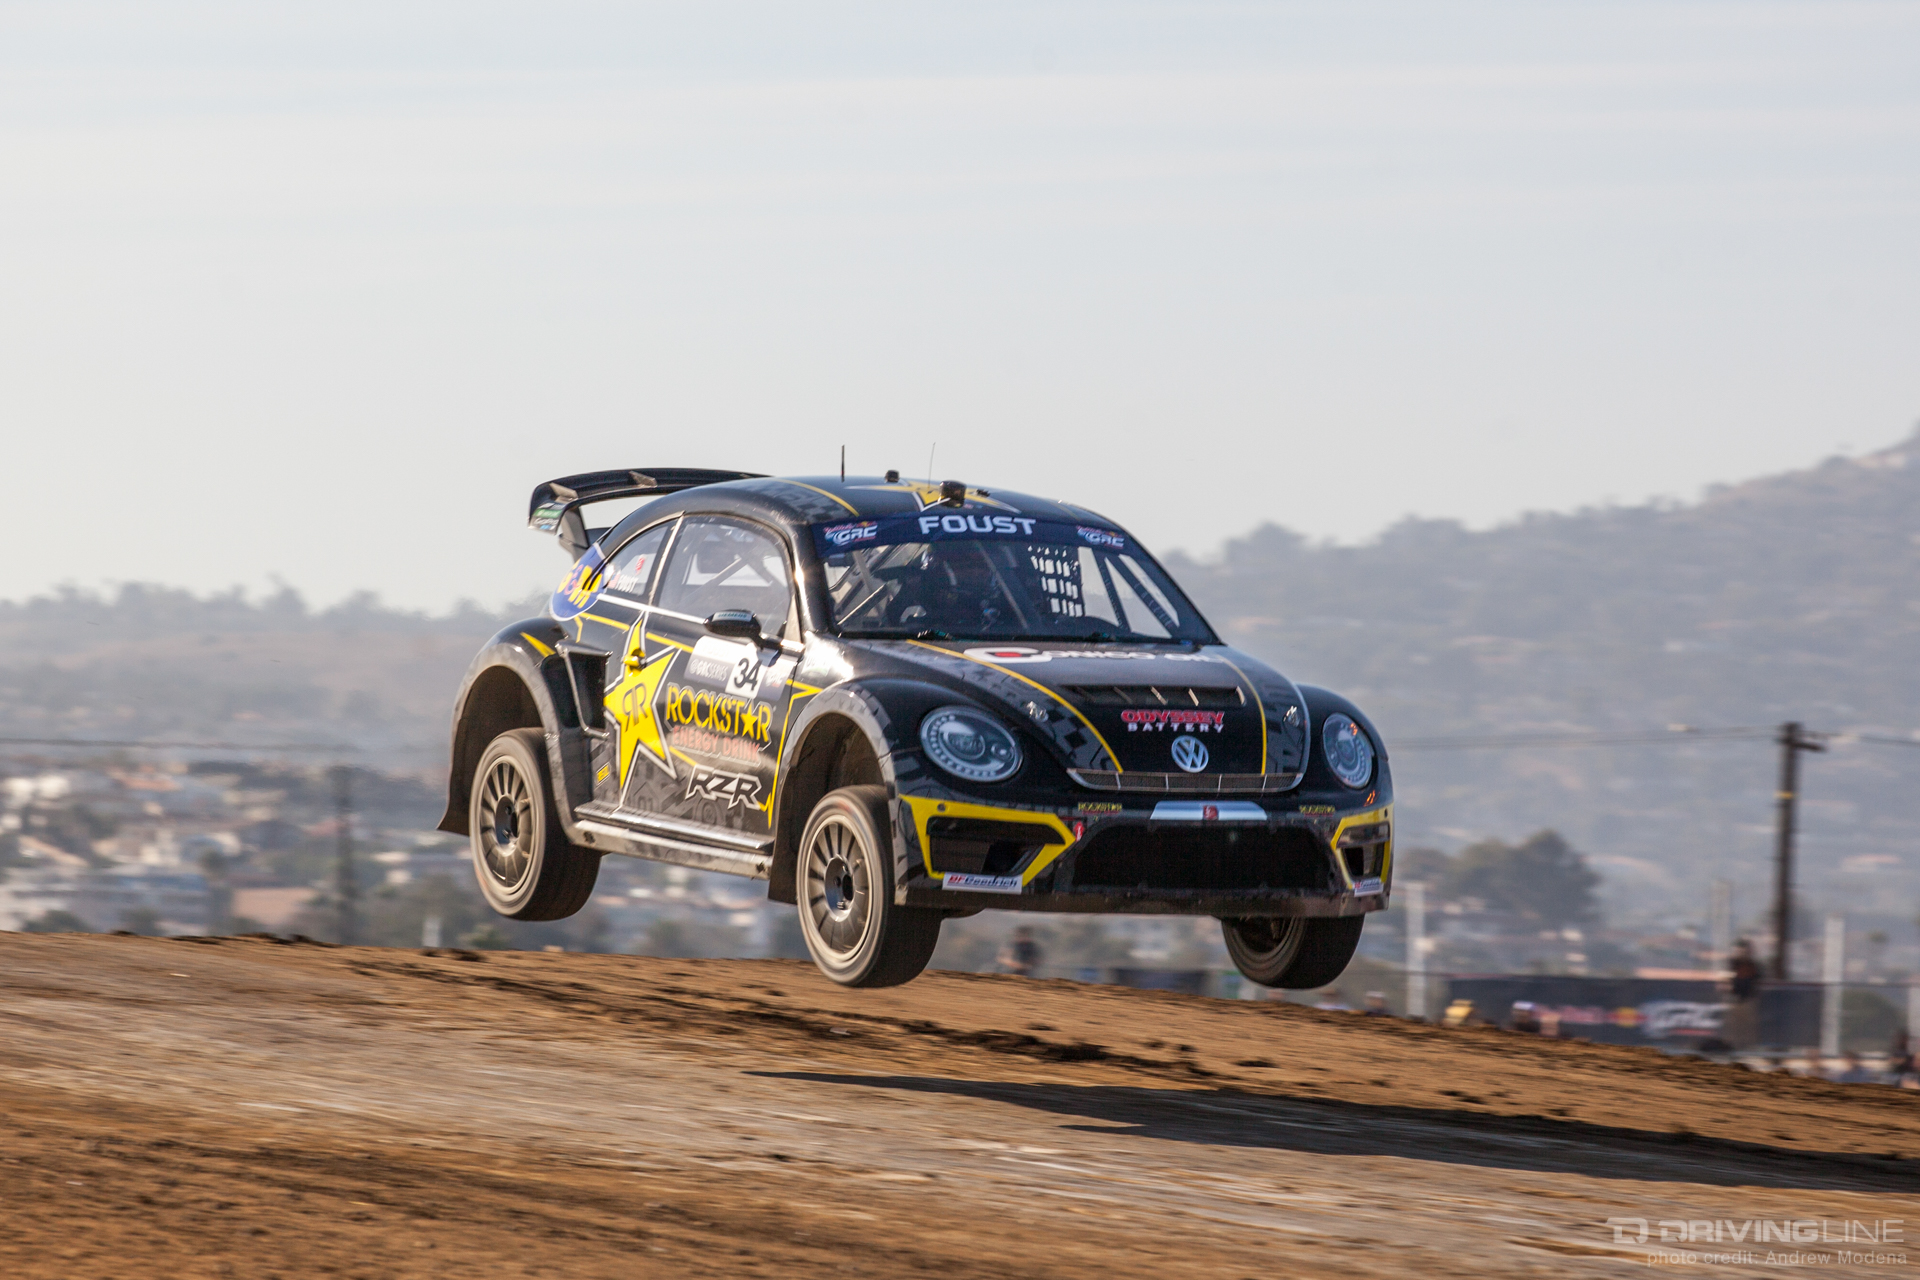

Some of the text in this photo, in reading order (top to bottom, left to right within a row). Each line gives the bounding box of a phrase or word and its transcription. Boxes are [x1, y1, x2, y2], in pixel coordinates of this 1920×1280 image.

[918, 514, 1037, 536] FOUST
[733, 657, 763, 692] 34
[1121, 710, 1225, 724] ODYSSEY
[1127, 722, 1224, 733] BATTERY
[673, 725, 760, 762] ENERGY DRINK
[688, 770, 759, 805] RZR
